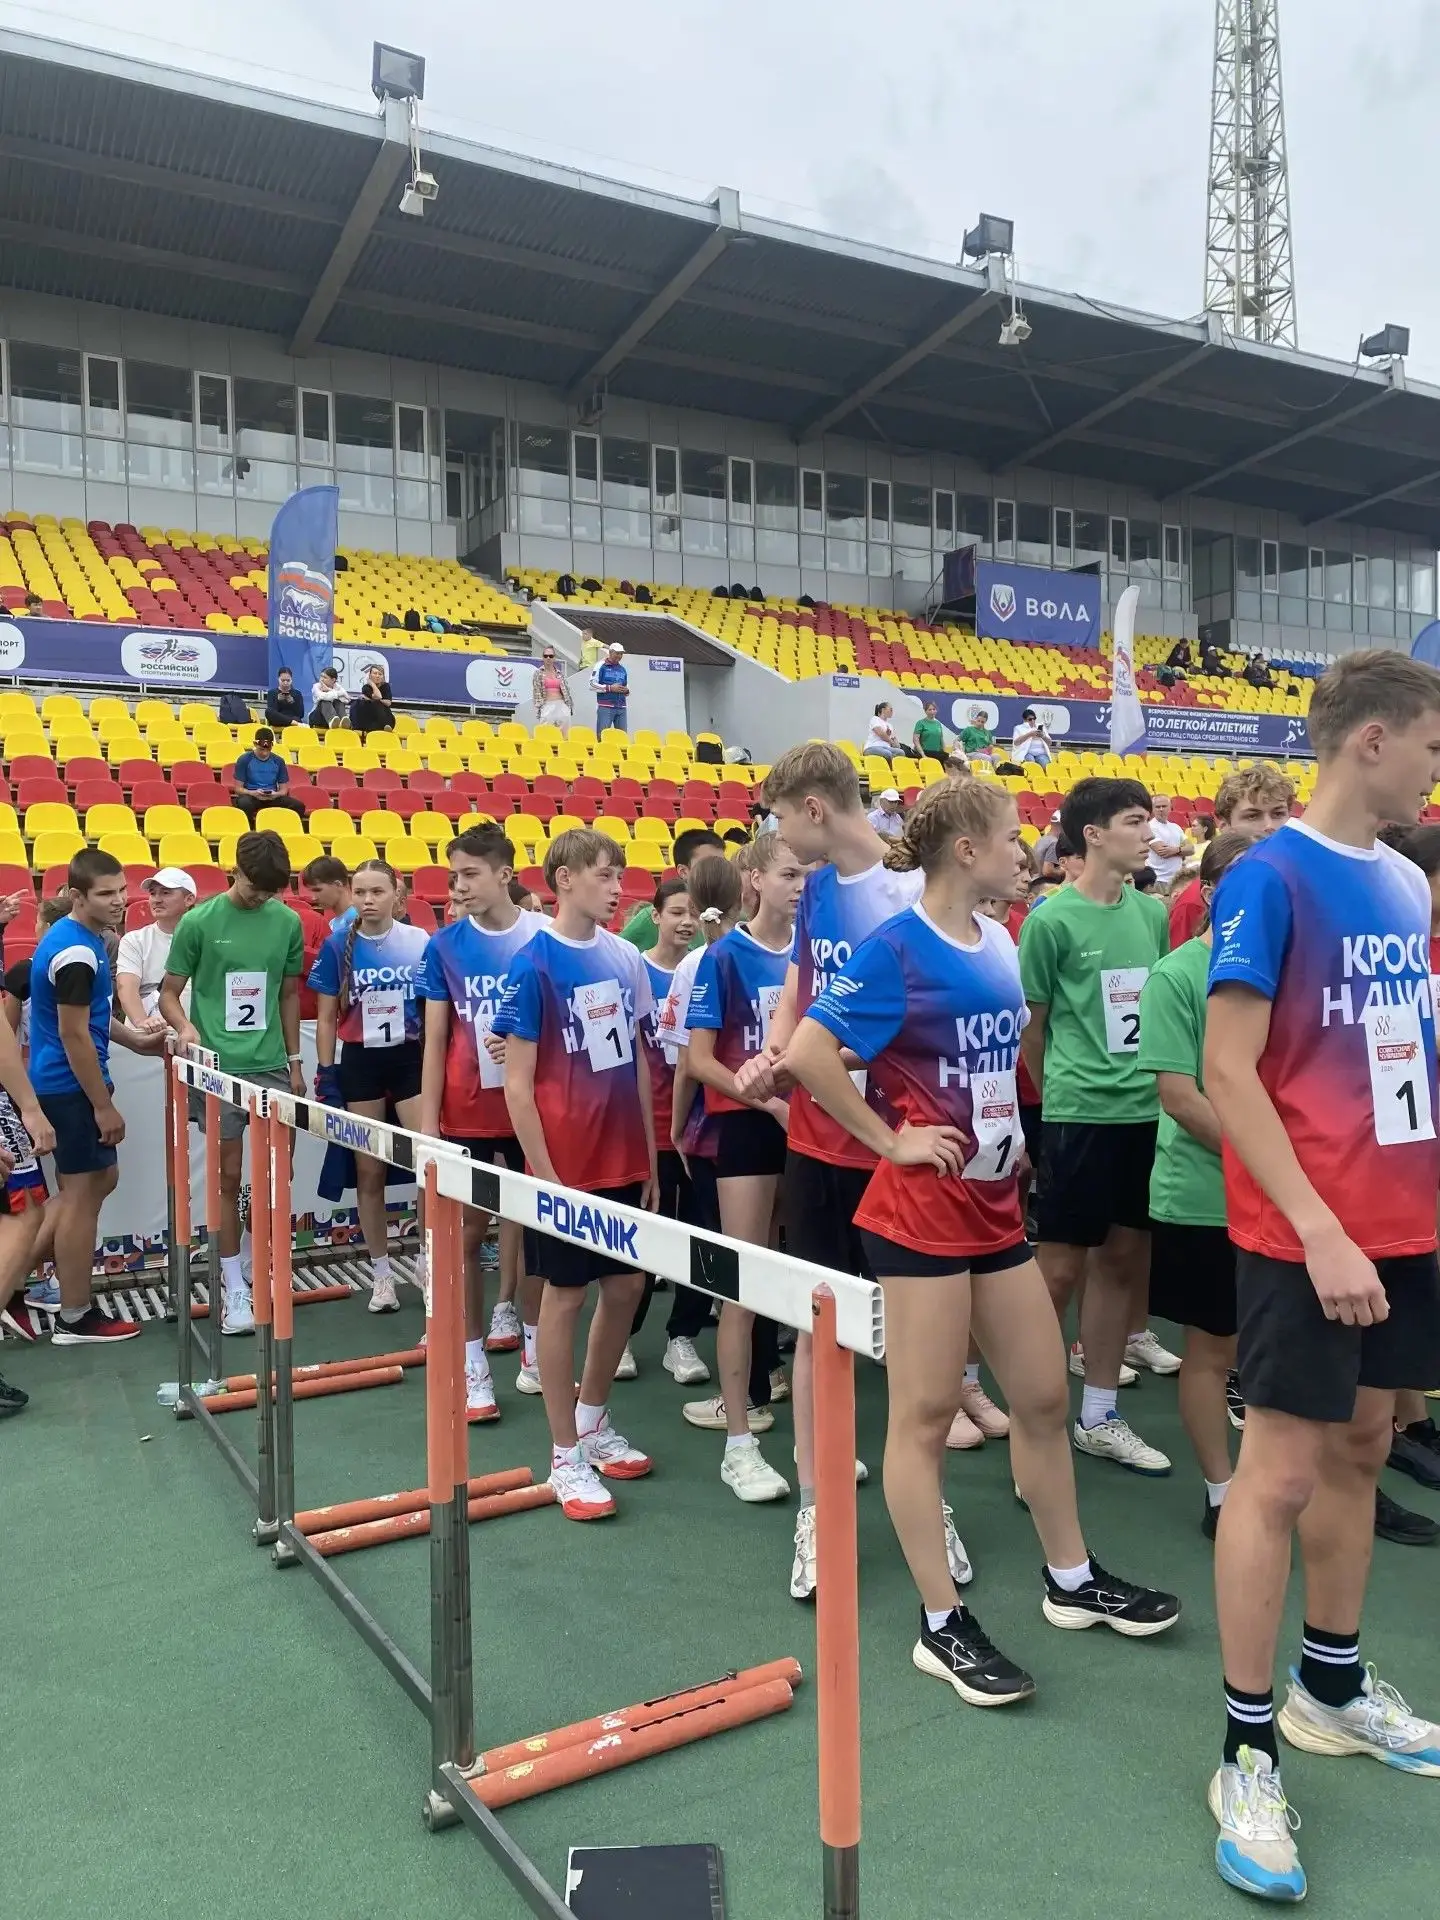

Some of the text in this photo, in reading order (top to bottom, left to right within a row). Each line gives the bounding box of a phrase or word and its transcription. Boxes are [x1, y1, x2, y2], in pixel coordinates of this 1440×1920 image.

[1025, 597, 1091, 623] ВФЛА
[279, 613, 328, 632] ЕДИНАЯ
[279, 625, 328, 644] РОССИЯ
[140, 663, 199, 673] РОССИЙСКИЙ
[1148, 717, 1260, 735] ПО ЛЕГКОЙ АТЛЕТИКЕ
[352, 965, 413, 987] КРОСС
[237, 1004, 255, 1027] 2
[376, 1021, 392, 1043] 1
[1121, 1013, 1140, 1046] 2
[605, 1026, 624, 1059] 1
[1395, 1079, 1419, 1132] 1
[325, 1112, 372, 1151] POLANIK
[996, 1134, 1013, 1174] 1
[537, 1190, 639, 1260] POLANIK
